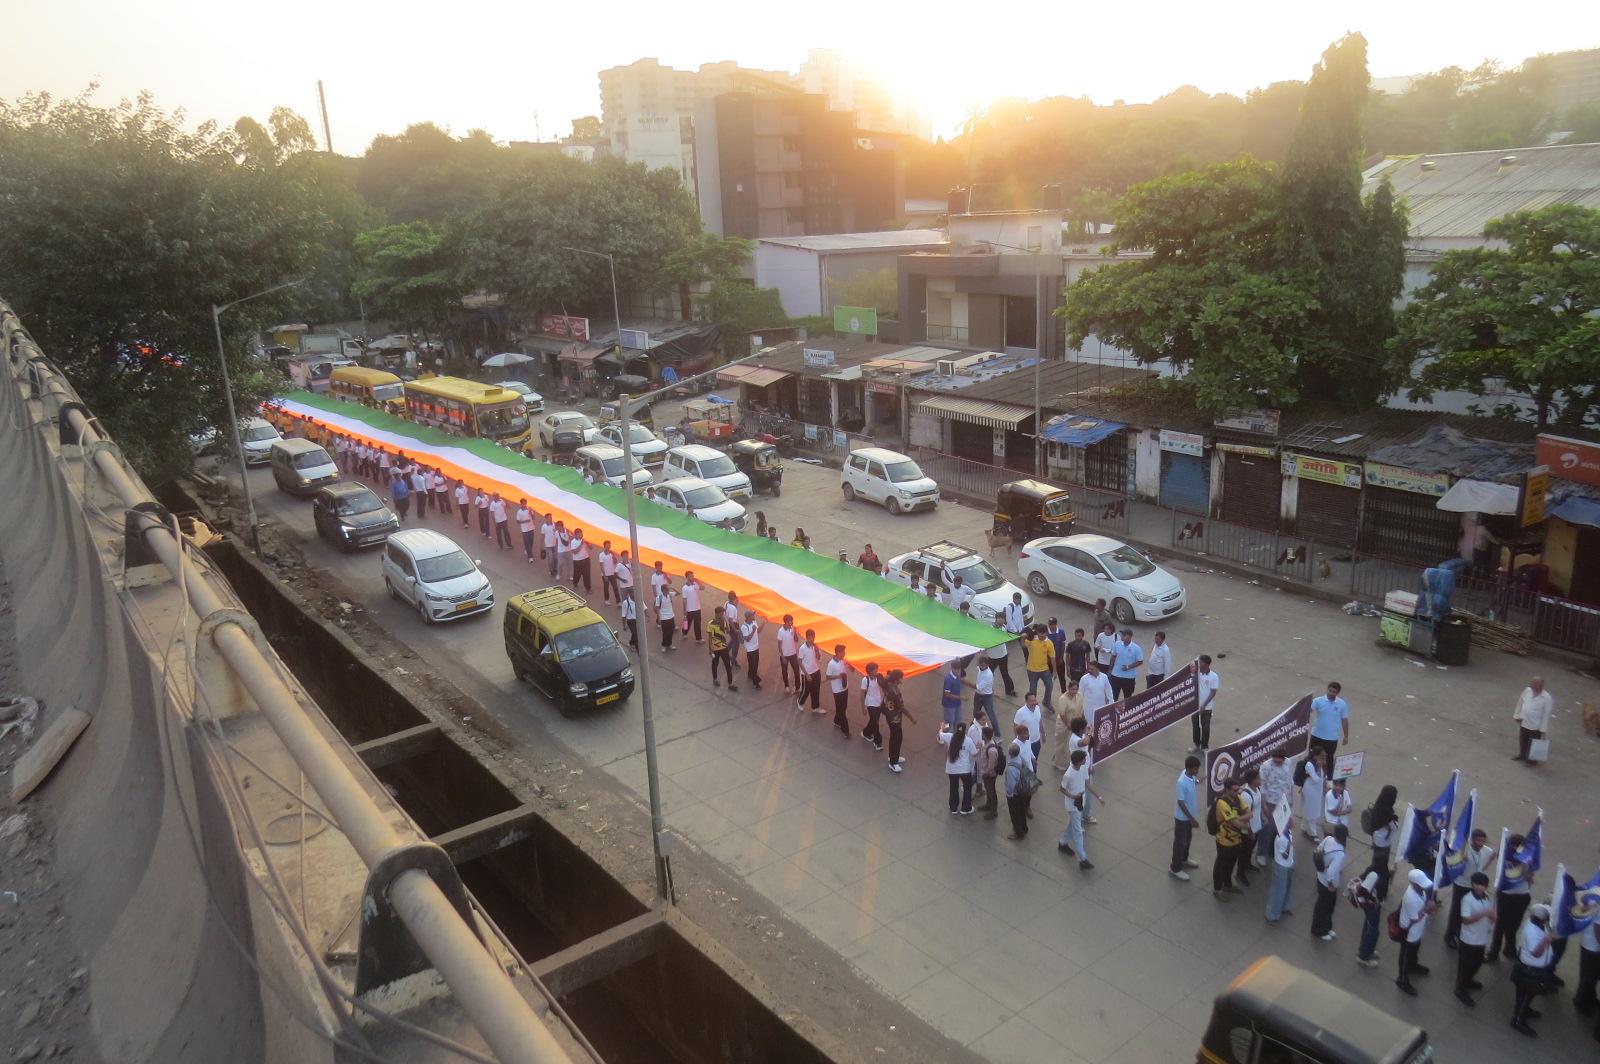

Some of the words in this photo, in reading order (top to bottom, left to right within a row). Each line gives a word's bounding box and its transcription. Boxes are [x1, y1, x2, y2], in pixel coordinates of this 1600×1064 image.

[1118, 707, 1154, 730] TECHNOLOGY
[1174, 686, 1195, 702] MUMBAI
[1119, 695, 1160, 720] MAHARASHTRA
[1185, 678, 1193, 688] OF
[1139, 720, 1146, 728] TO
[1145, 716, 1153, 725] THE
[1239, 736, 1287, 769] INTERNATIONAL
[1240, 746, 1253, 759] MIT
